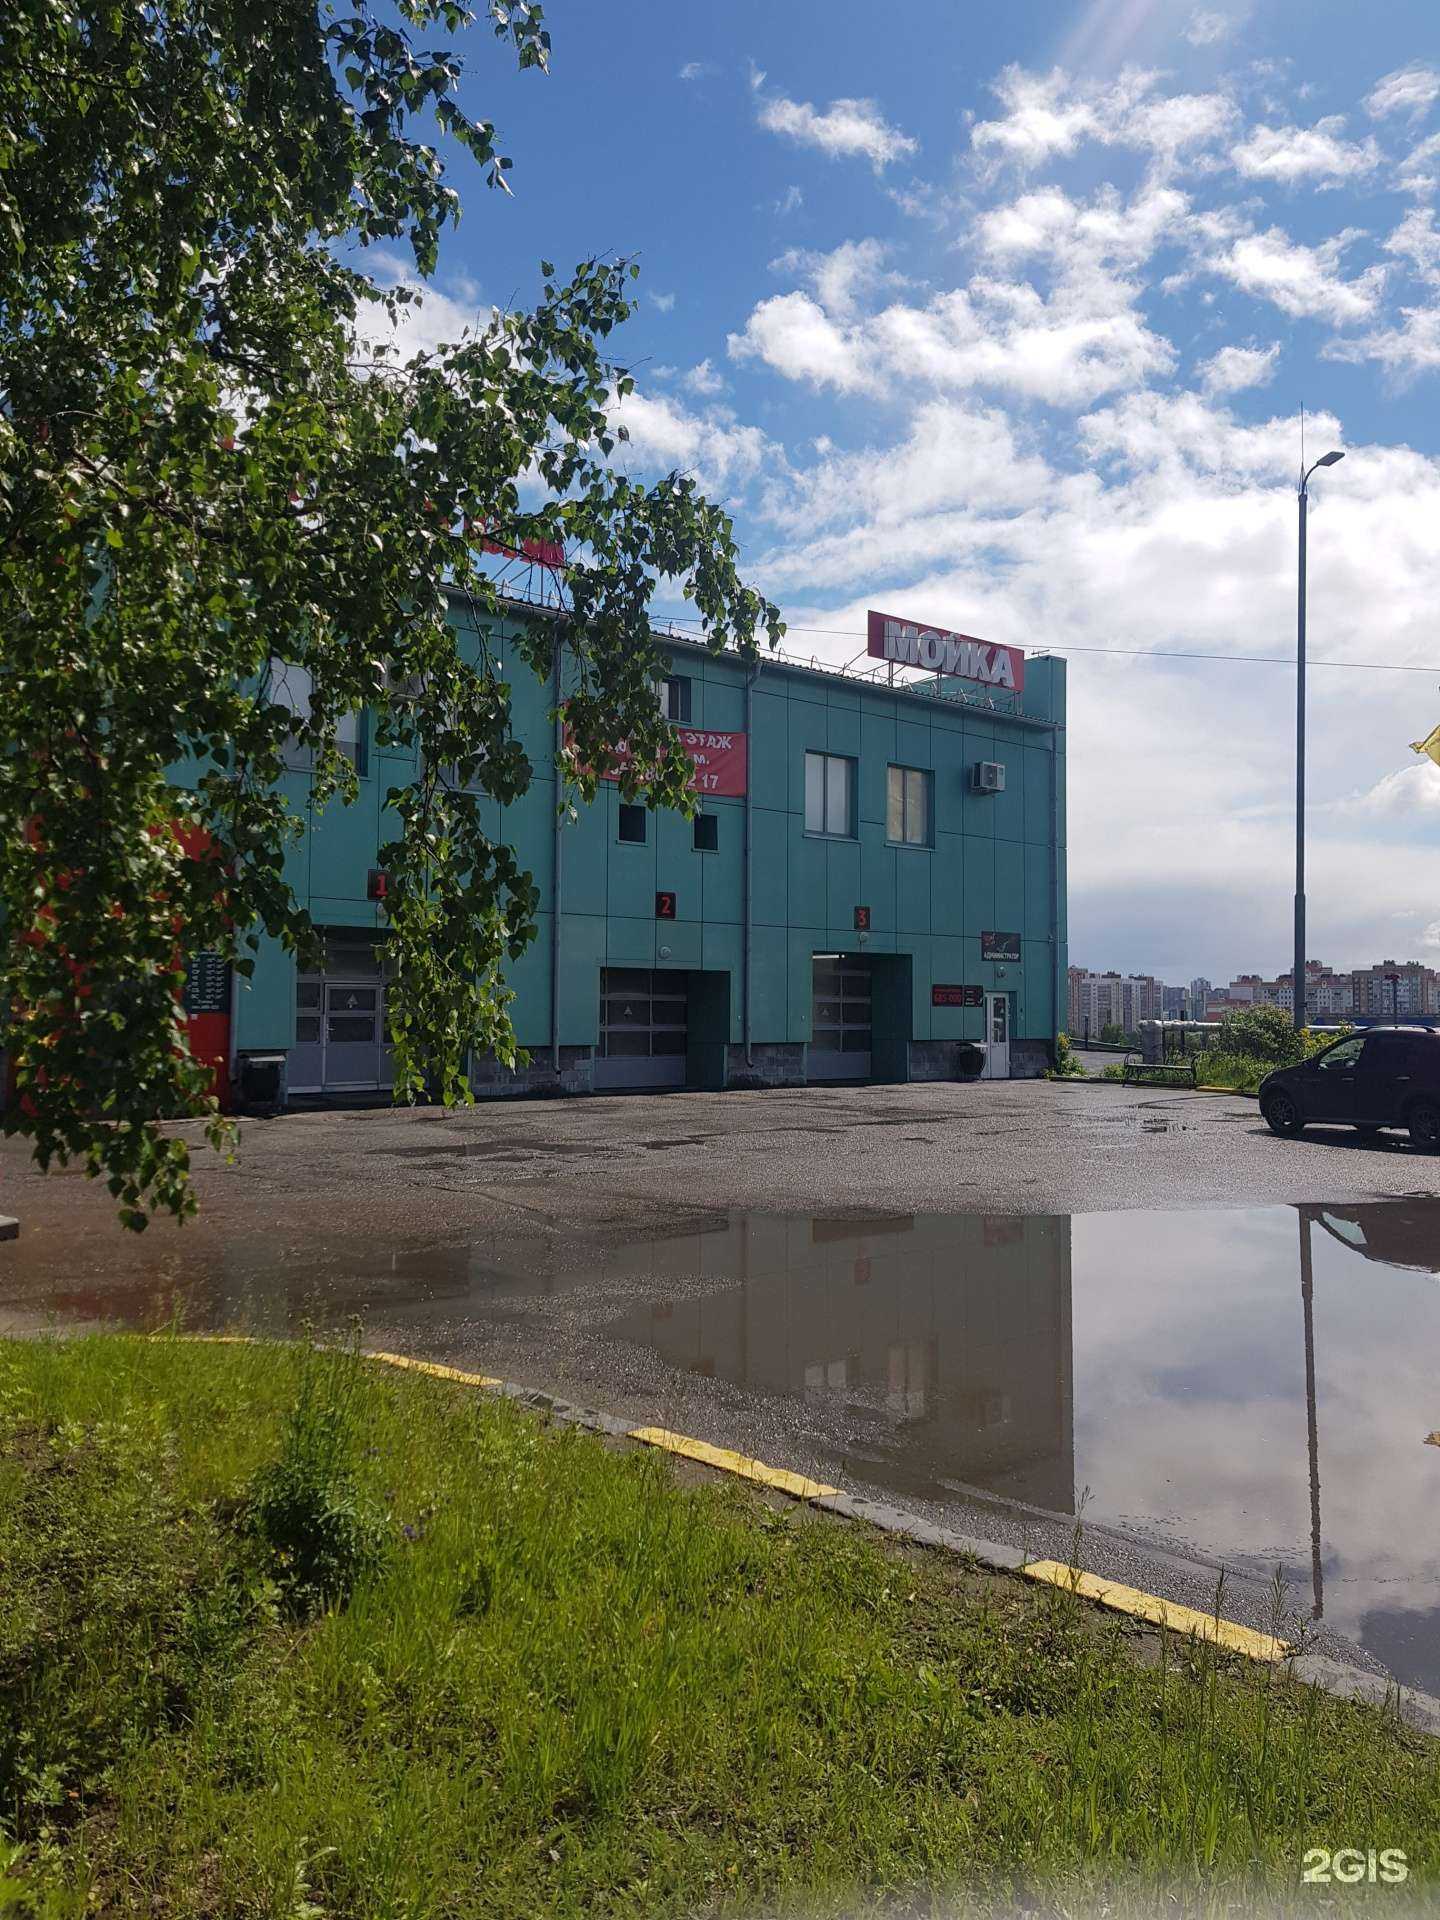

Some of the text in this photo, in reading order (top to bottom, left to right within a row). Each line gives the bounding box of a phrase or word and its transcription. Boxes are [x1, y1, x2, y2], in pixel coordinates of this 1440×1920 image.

[883, 620, 1016, 688] МОЙКА
[685, 732, 732, 749] ЭТАЖ
[702, 773, 719, 789] 17
[375, 874, 389, 897] 1
[661, 895, 671, 914] 2
[857, 909, 867, 926] 3
